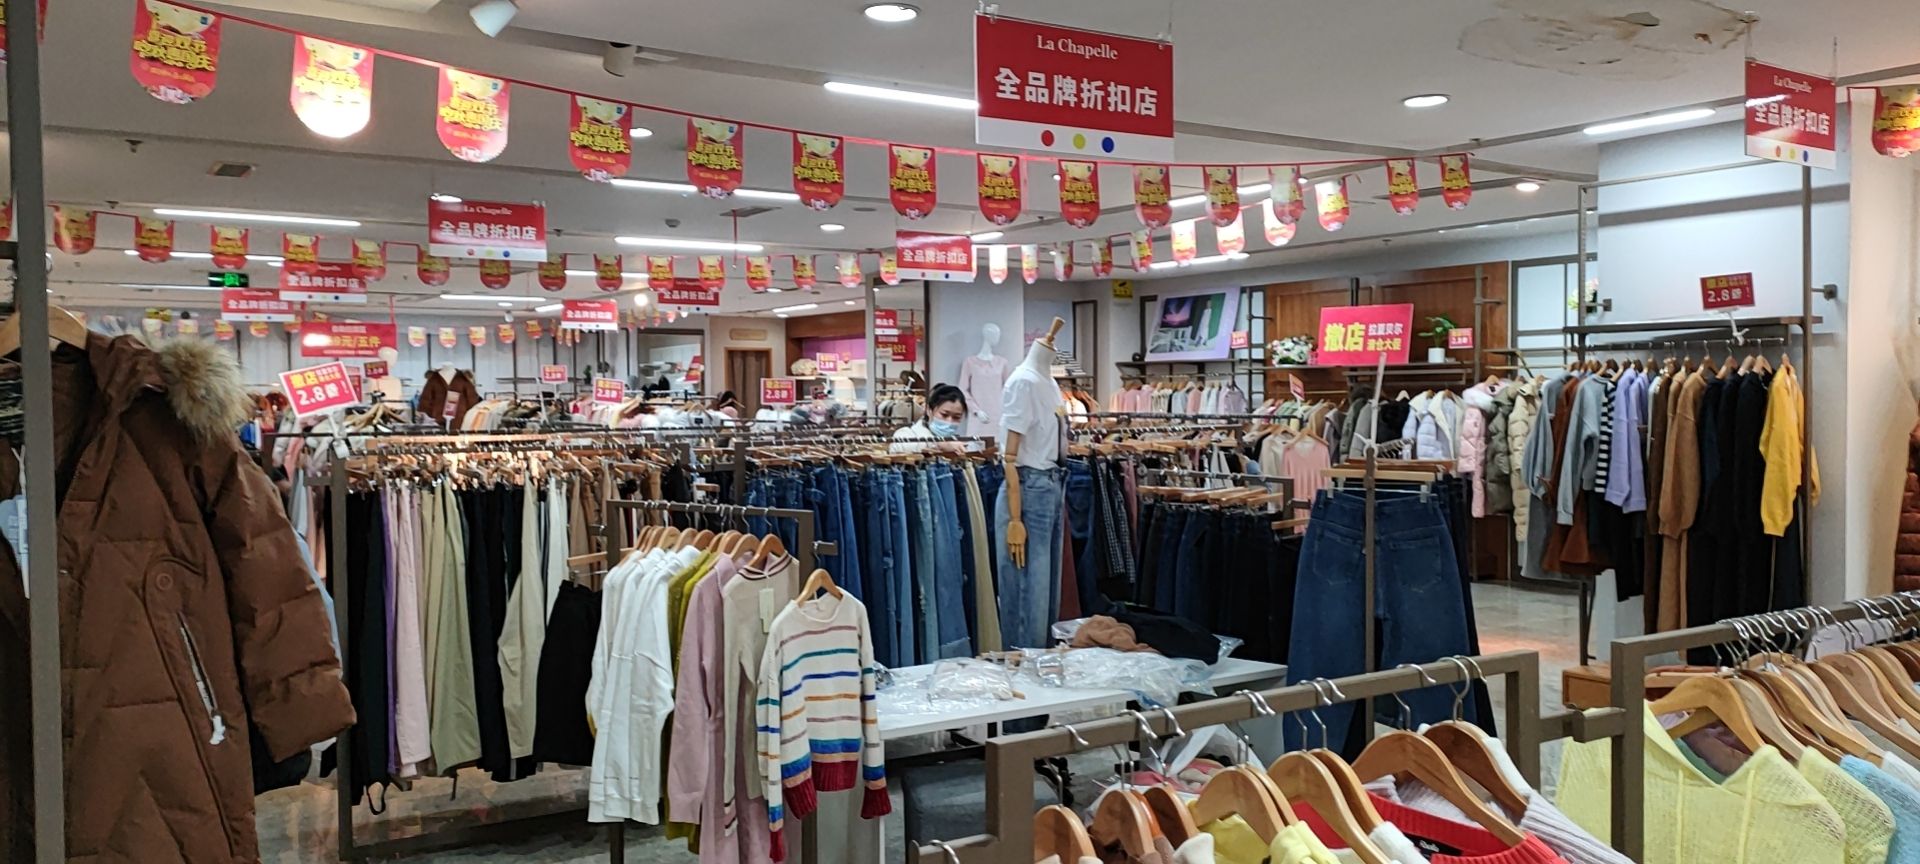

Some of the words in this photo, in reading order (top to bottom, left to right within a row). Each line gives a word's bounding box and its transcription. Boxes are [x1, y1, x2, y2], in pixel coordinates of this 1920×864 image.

[1036, 34, 1055, 51] La
[1057, 38, 1119, 60] Chapelle
[995, 67, 1158, 117] 全品牌折扣店
[1754, 101, 1830, 136] 全品牌折扣店
[440, 220, 537, 241] 全品牌折扣店
[903, 248, 968, 265] 全品牌折扣店
[1324, 322, 1365, 352] 撤店
